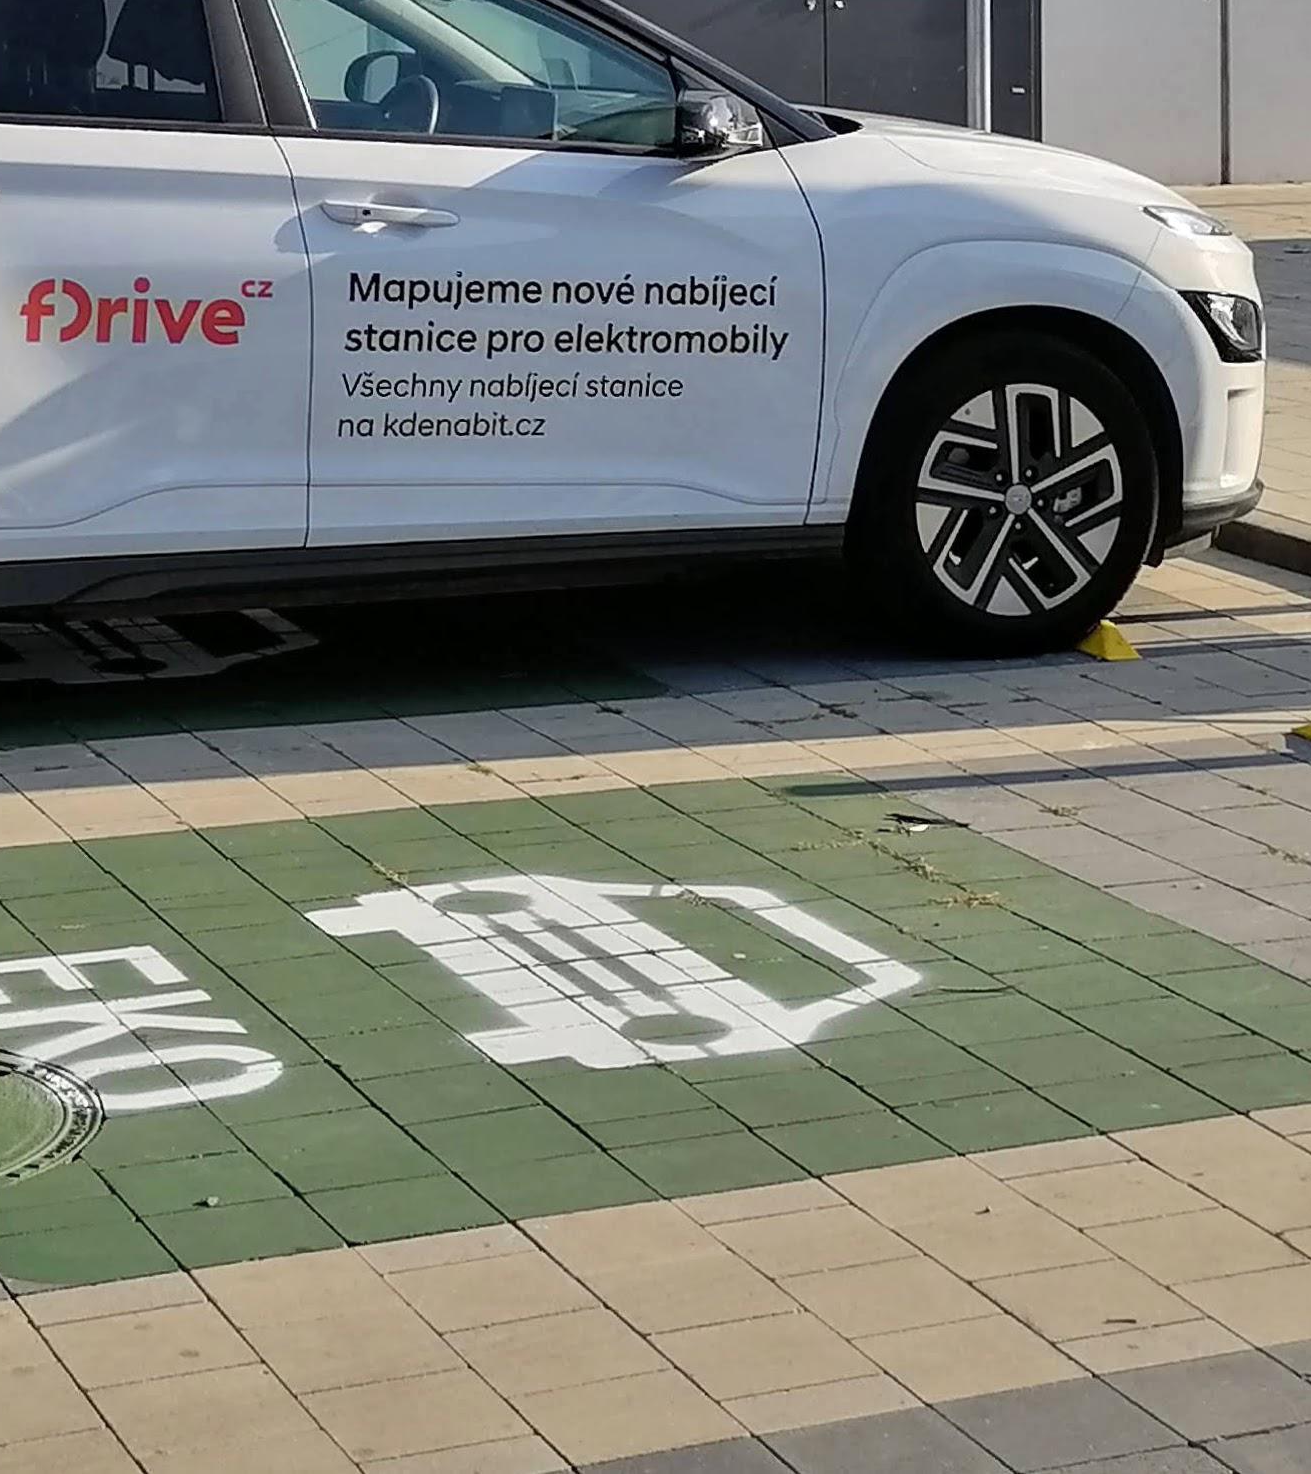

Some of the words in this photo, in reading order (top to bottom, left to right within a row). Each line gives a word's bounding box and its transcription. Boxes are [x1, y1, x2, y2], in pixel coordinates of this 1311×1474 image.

[348, 271, 543, 311] Mapujeme
[553, 273, 635, 305] nové
[645, 275, 778, 312] nabíjecí
[344, 321, 478, 354] stanice
[486, 328, 545, 359] pro
[554, 323, 789, 360] elektromobily
[342, 371, 463, 403] Všechny
[469, 371, 580, 403] nabíjecí
[585, 371, 685, 398] stanice
[337, 417, 374, 438] na
[383, 411, 546, 438] kdenabit.cz
